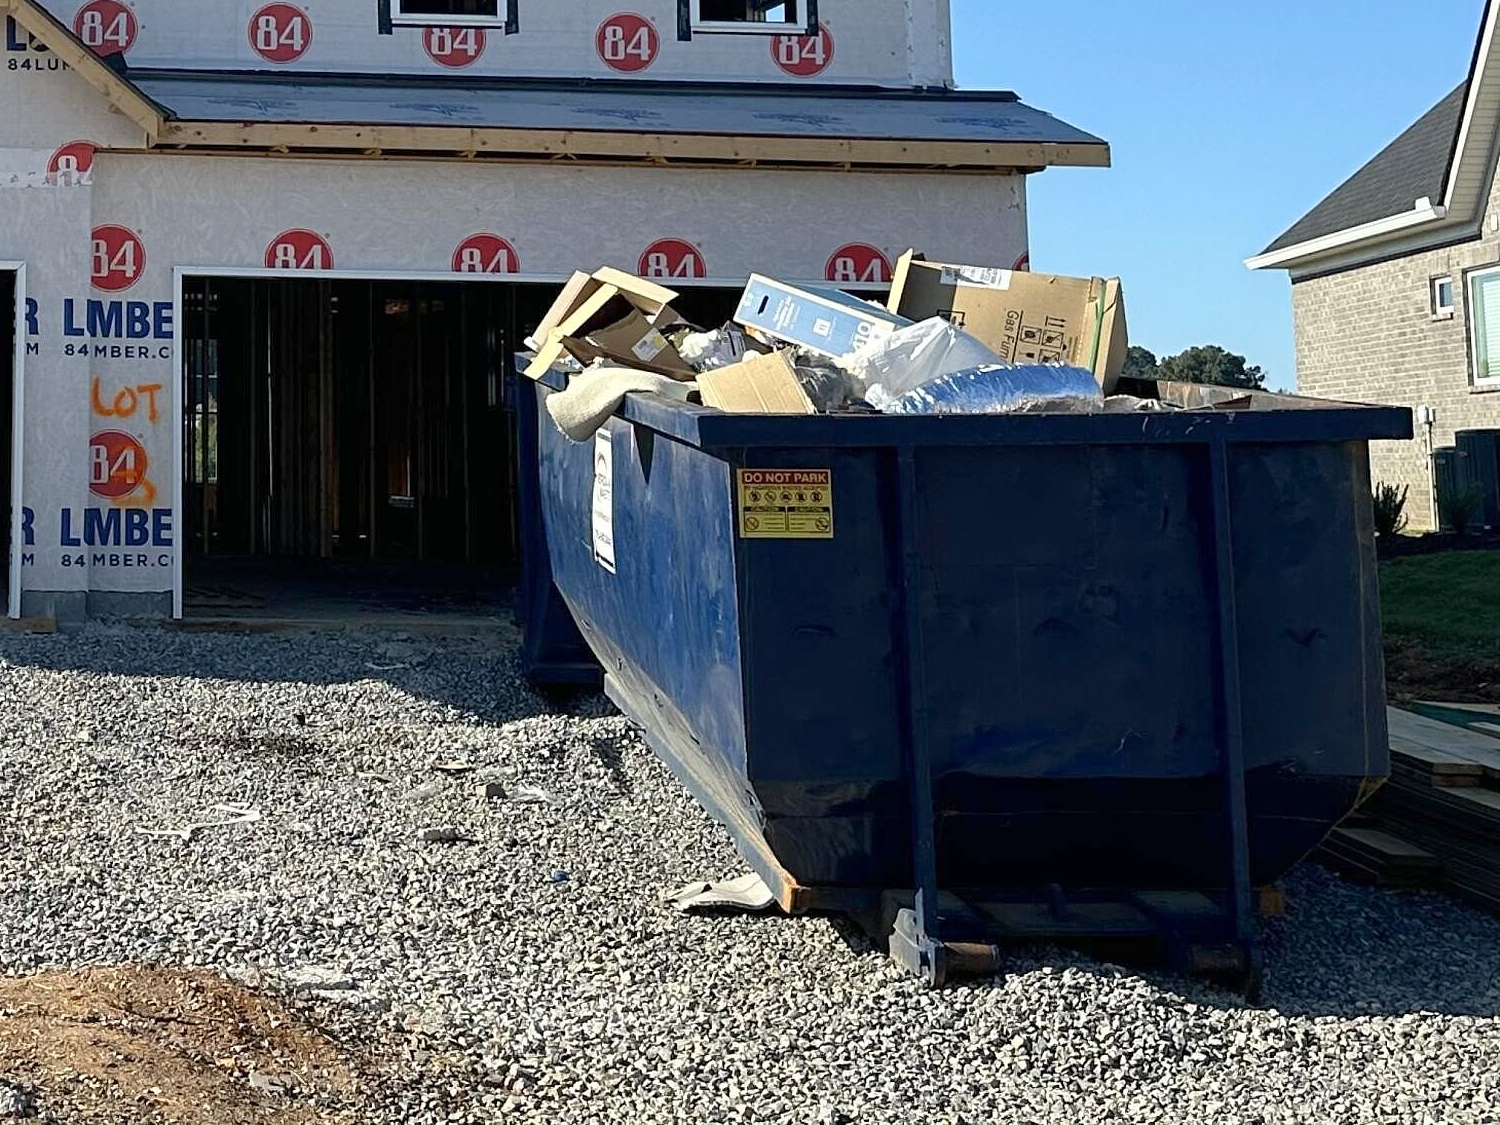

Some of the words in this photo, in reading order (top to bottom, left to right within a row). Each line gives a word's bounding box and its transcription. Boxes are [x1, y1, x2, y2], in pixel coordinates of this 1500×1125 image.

[82, 11, 129, 47] 84
[257, 15, 304, 51] 84
[604, 25, 651, 61] 84
[91, 376, 163, 424] LOT
[744, 472, 762, 483] DO
[765, 472, 791, 483] NOT
[794, 473, 827, 483] PARK
